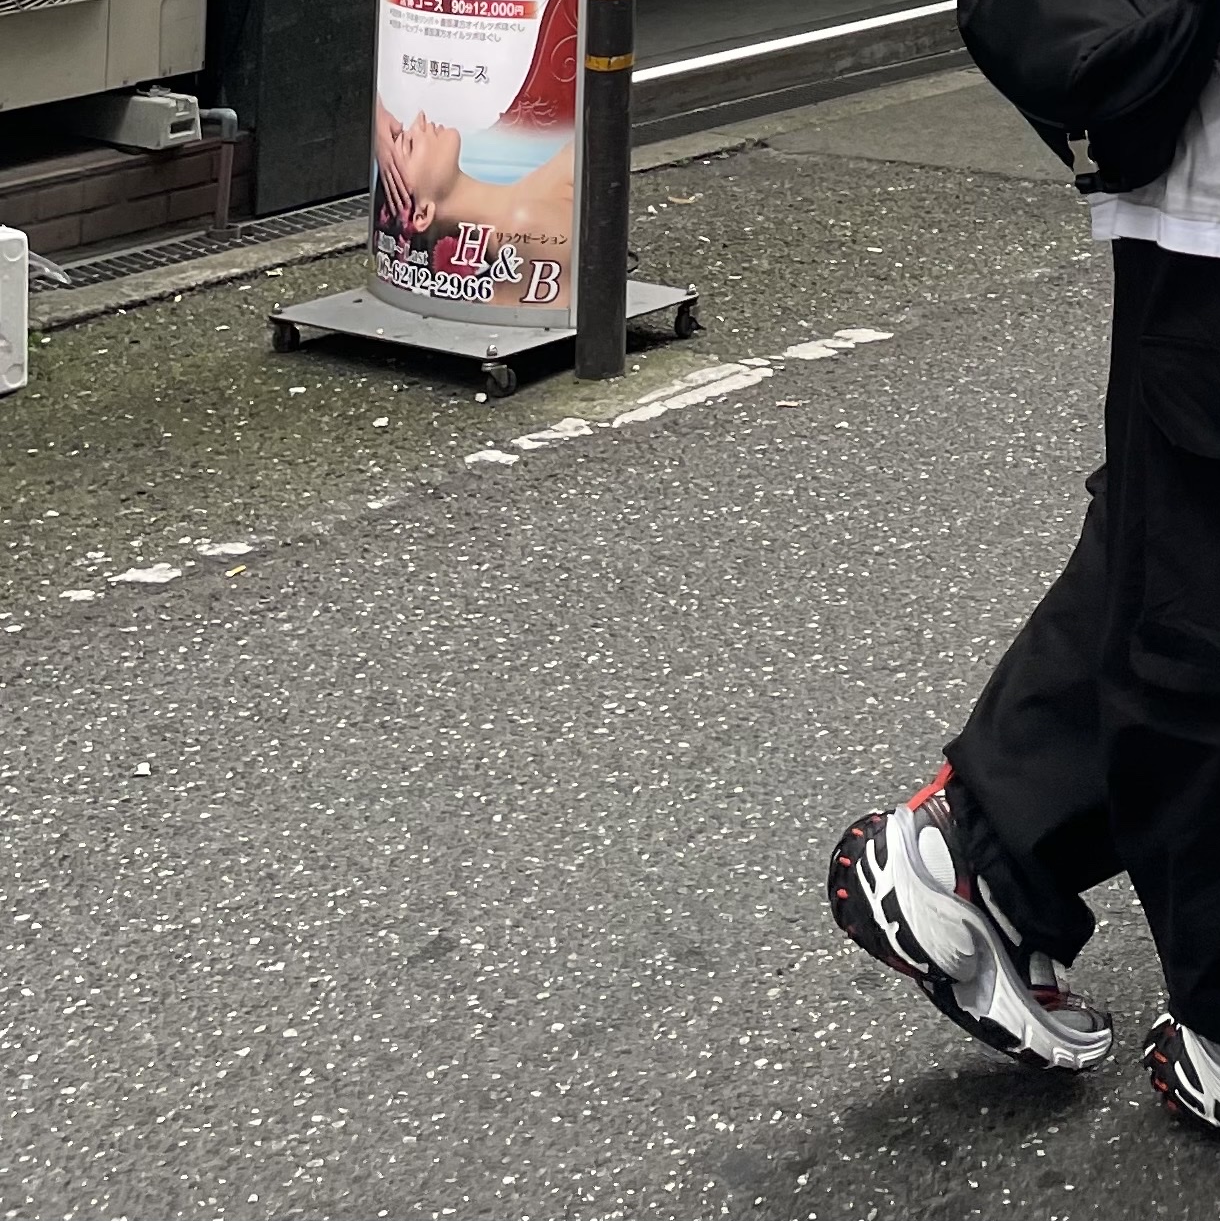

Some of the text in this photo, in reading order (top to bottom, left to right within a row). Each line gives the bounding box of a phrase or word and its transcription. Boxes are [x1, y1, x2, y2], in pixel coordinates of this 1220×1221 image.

[451, 0, 525, 17] 90分12,000円
[402, 53, 488, 80] 男女別 専用コース
[495, 231, 569, 246] リラクゼーション
[451, 222, 495, 267] H
[490, 244, 524, 282] &
[521, 260, 562, 304] B
